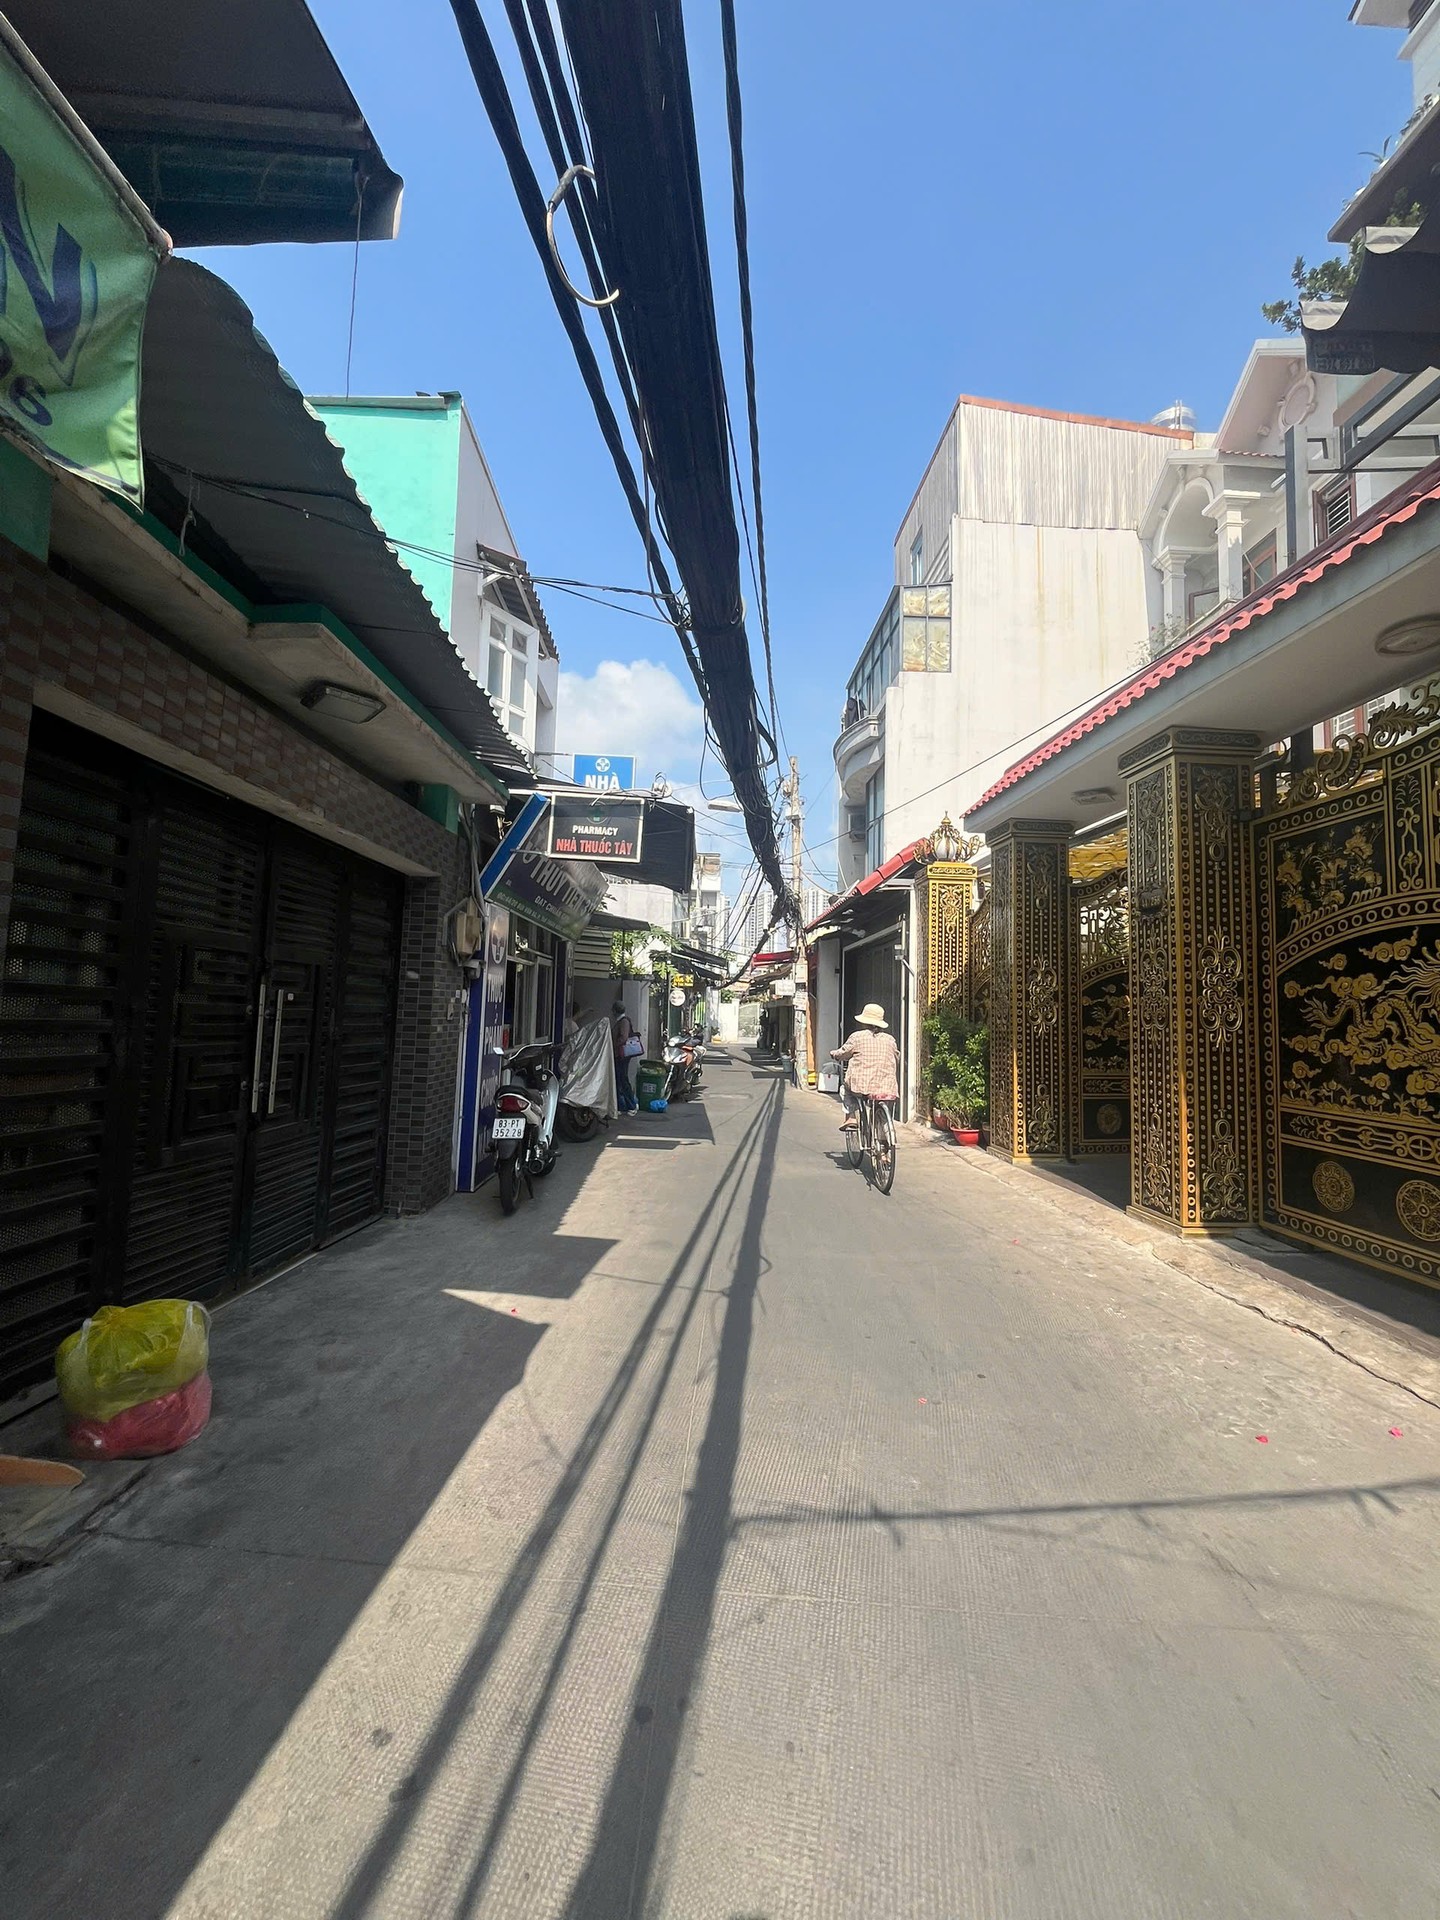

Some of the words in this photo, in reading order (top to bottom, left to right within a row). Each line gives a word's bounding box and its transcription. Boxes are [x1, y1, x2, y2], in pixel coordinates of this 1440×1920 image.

[585, 772, 620, 790] NHÀ
[572, 825, 618, 836] PHARMACY
[556, 837, 577, 852] NHÀ
[580, 837, 612, 854] THUỐC
[614, 840, 633, 855] TÂY
